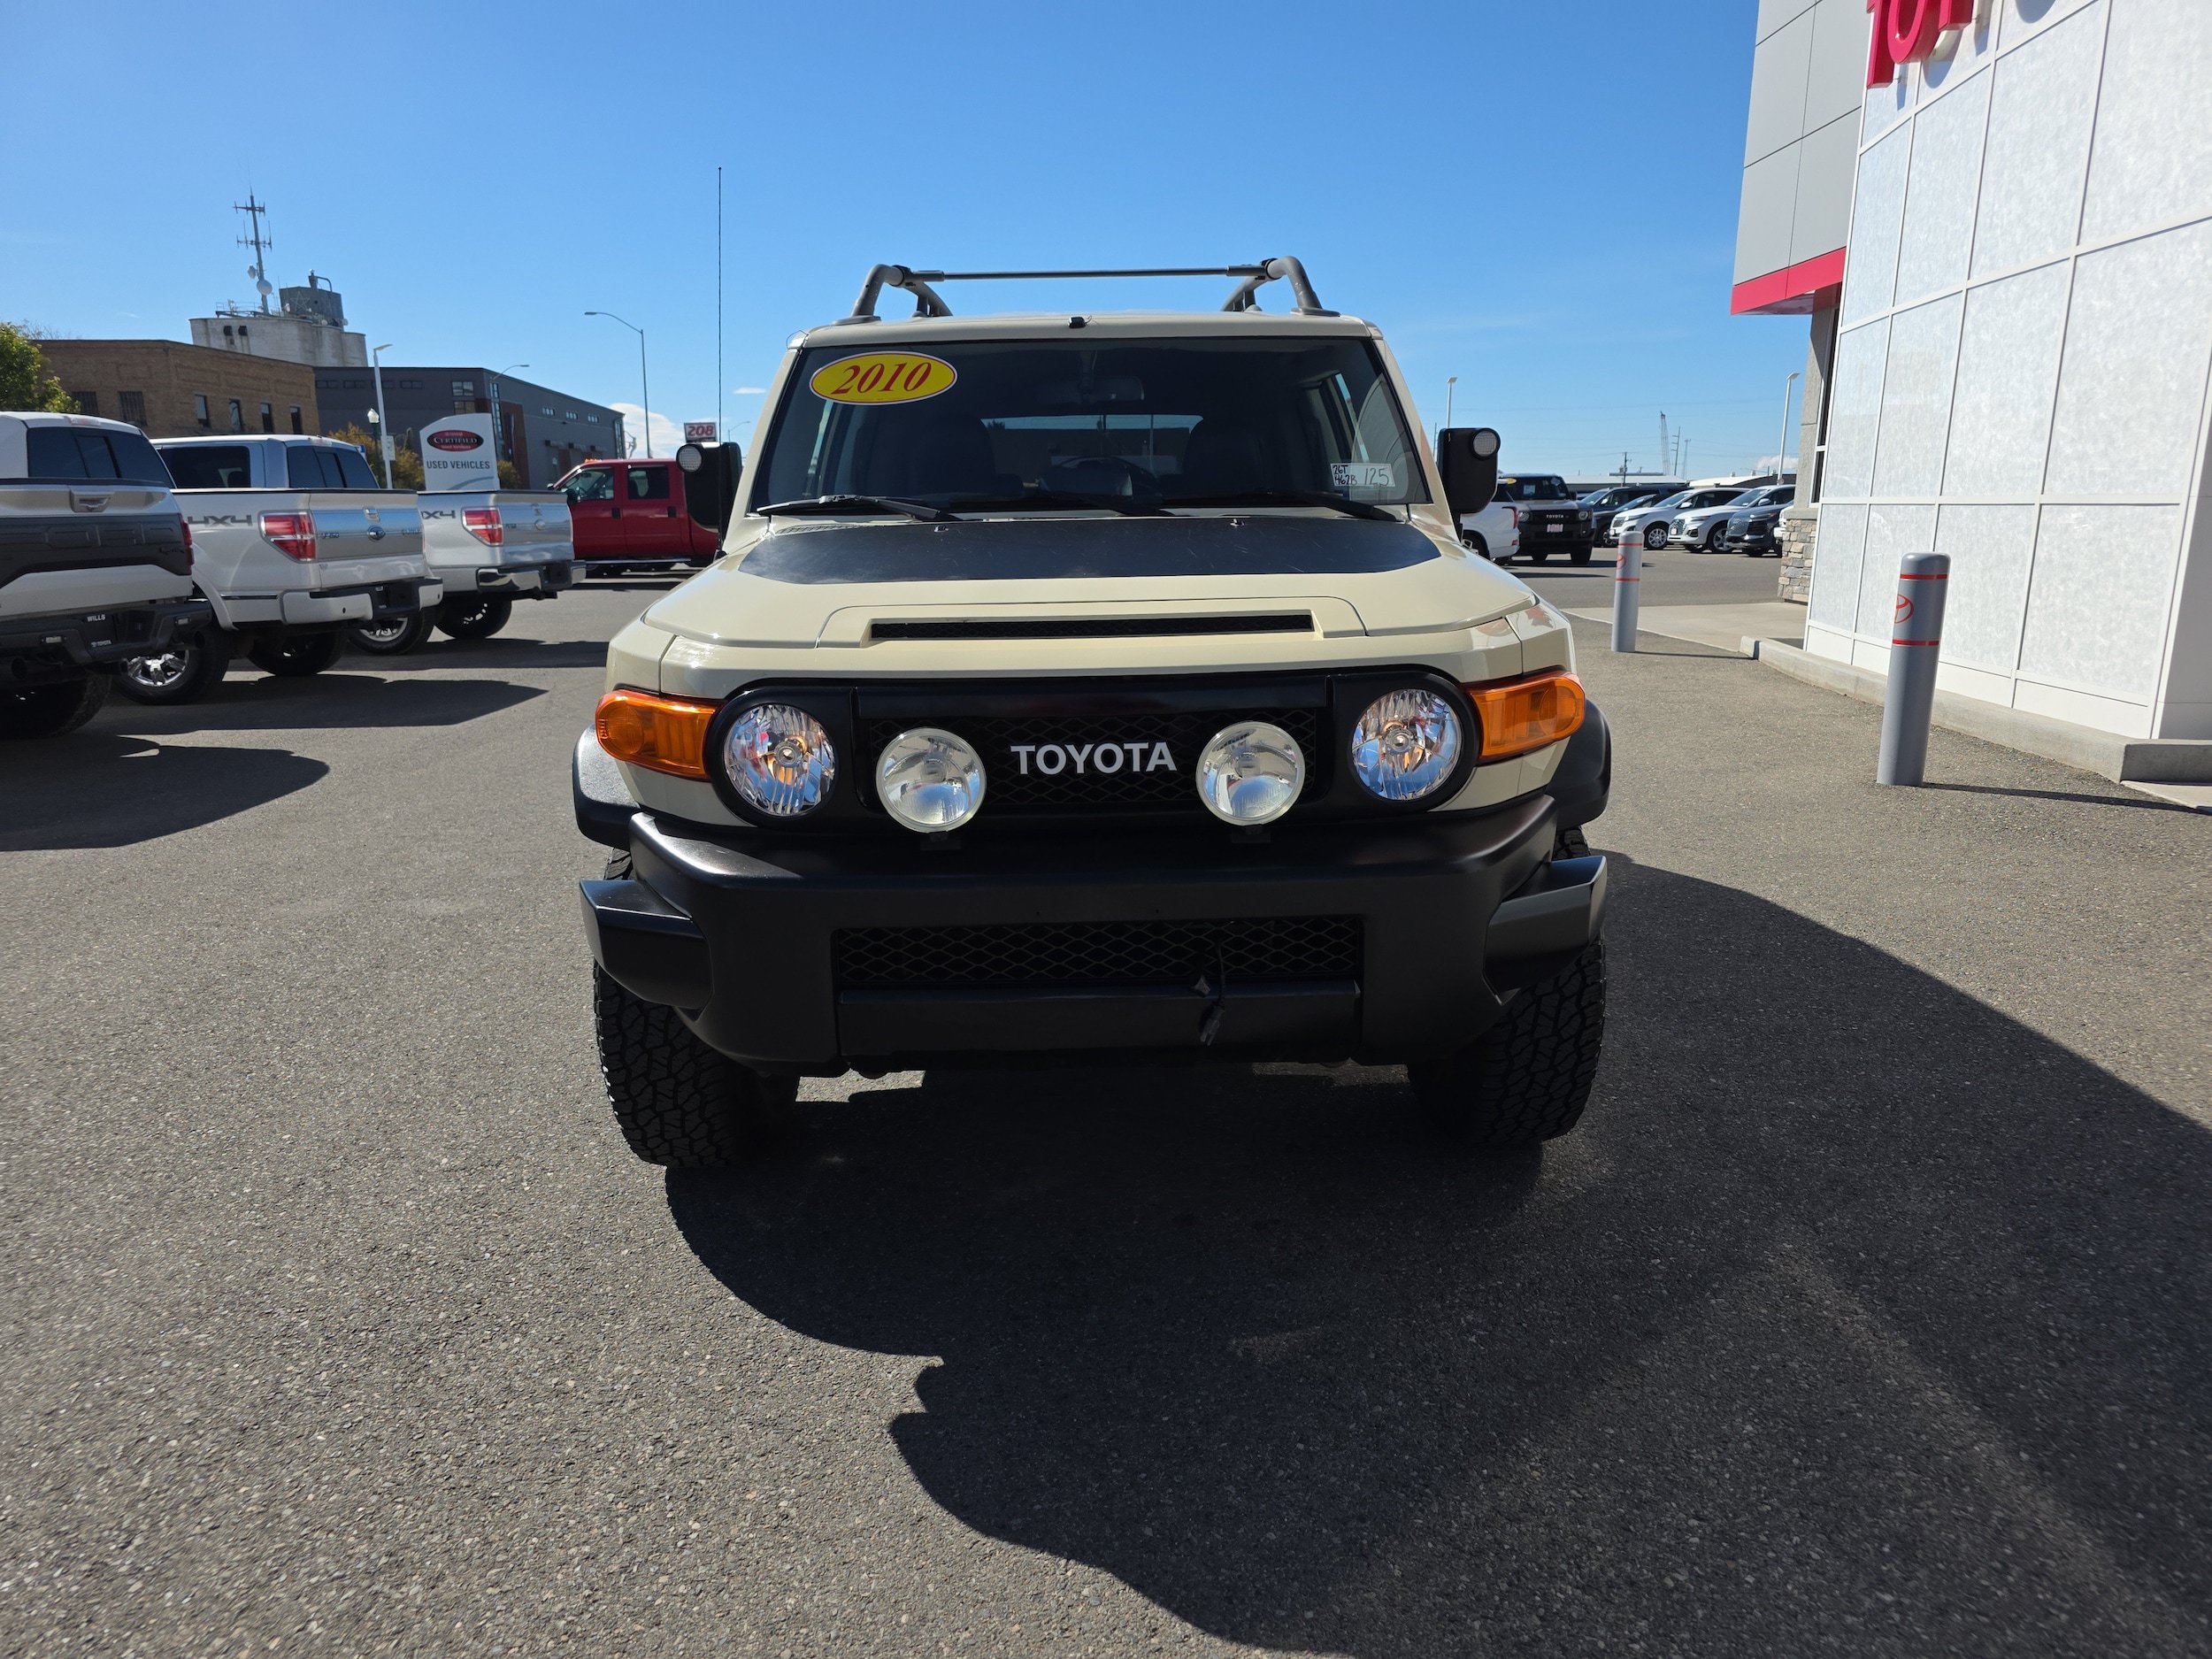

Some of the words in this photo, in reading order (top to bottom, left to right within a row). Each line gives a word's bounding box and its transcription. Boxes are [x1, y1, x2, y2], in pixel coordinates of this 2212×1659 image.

[830, 361, 933, 395] 2010
[687, 425, 714, 436] 208
[426, 460, 449, 470] USED
[450, 460, 490, 470] VEHICLES
[1364, 467, 1390, 487] 125
[187, 514, 253, 527] 4X4
[87, 613, 106, 622] WILLS
[1010, 741, 1178, 775] TOYOTA
